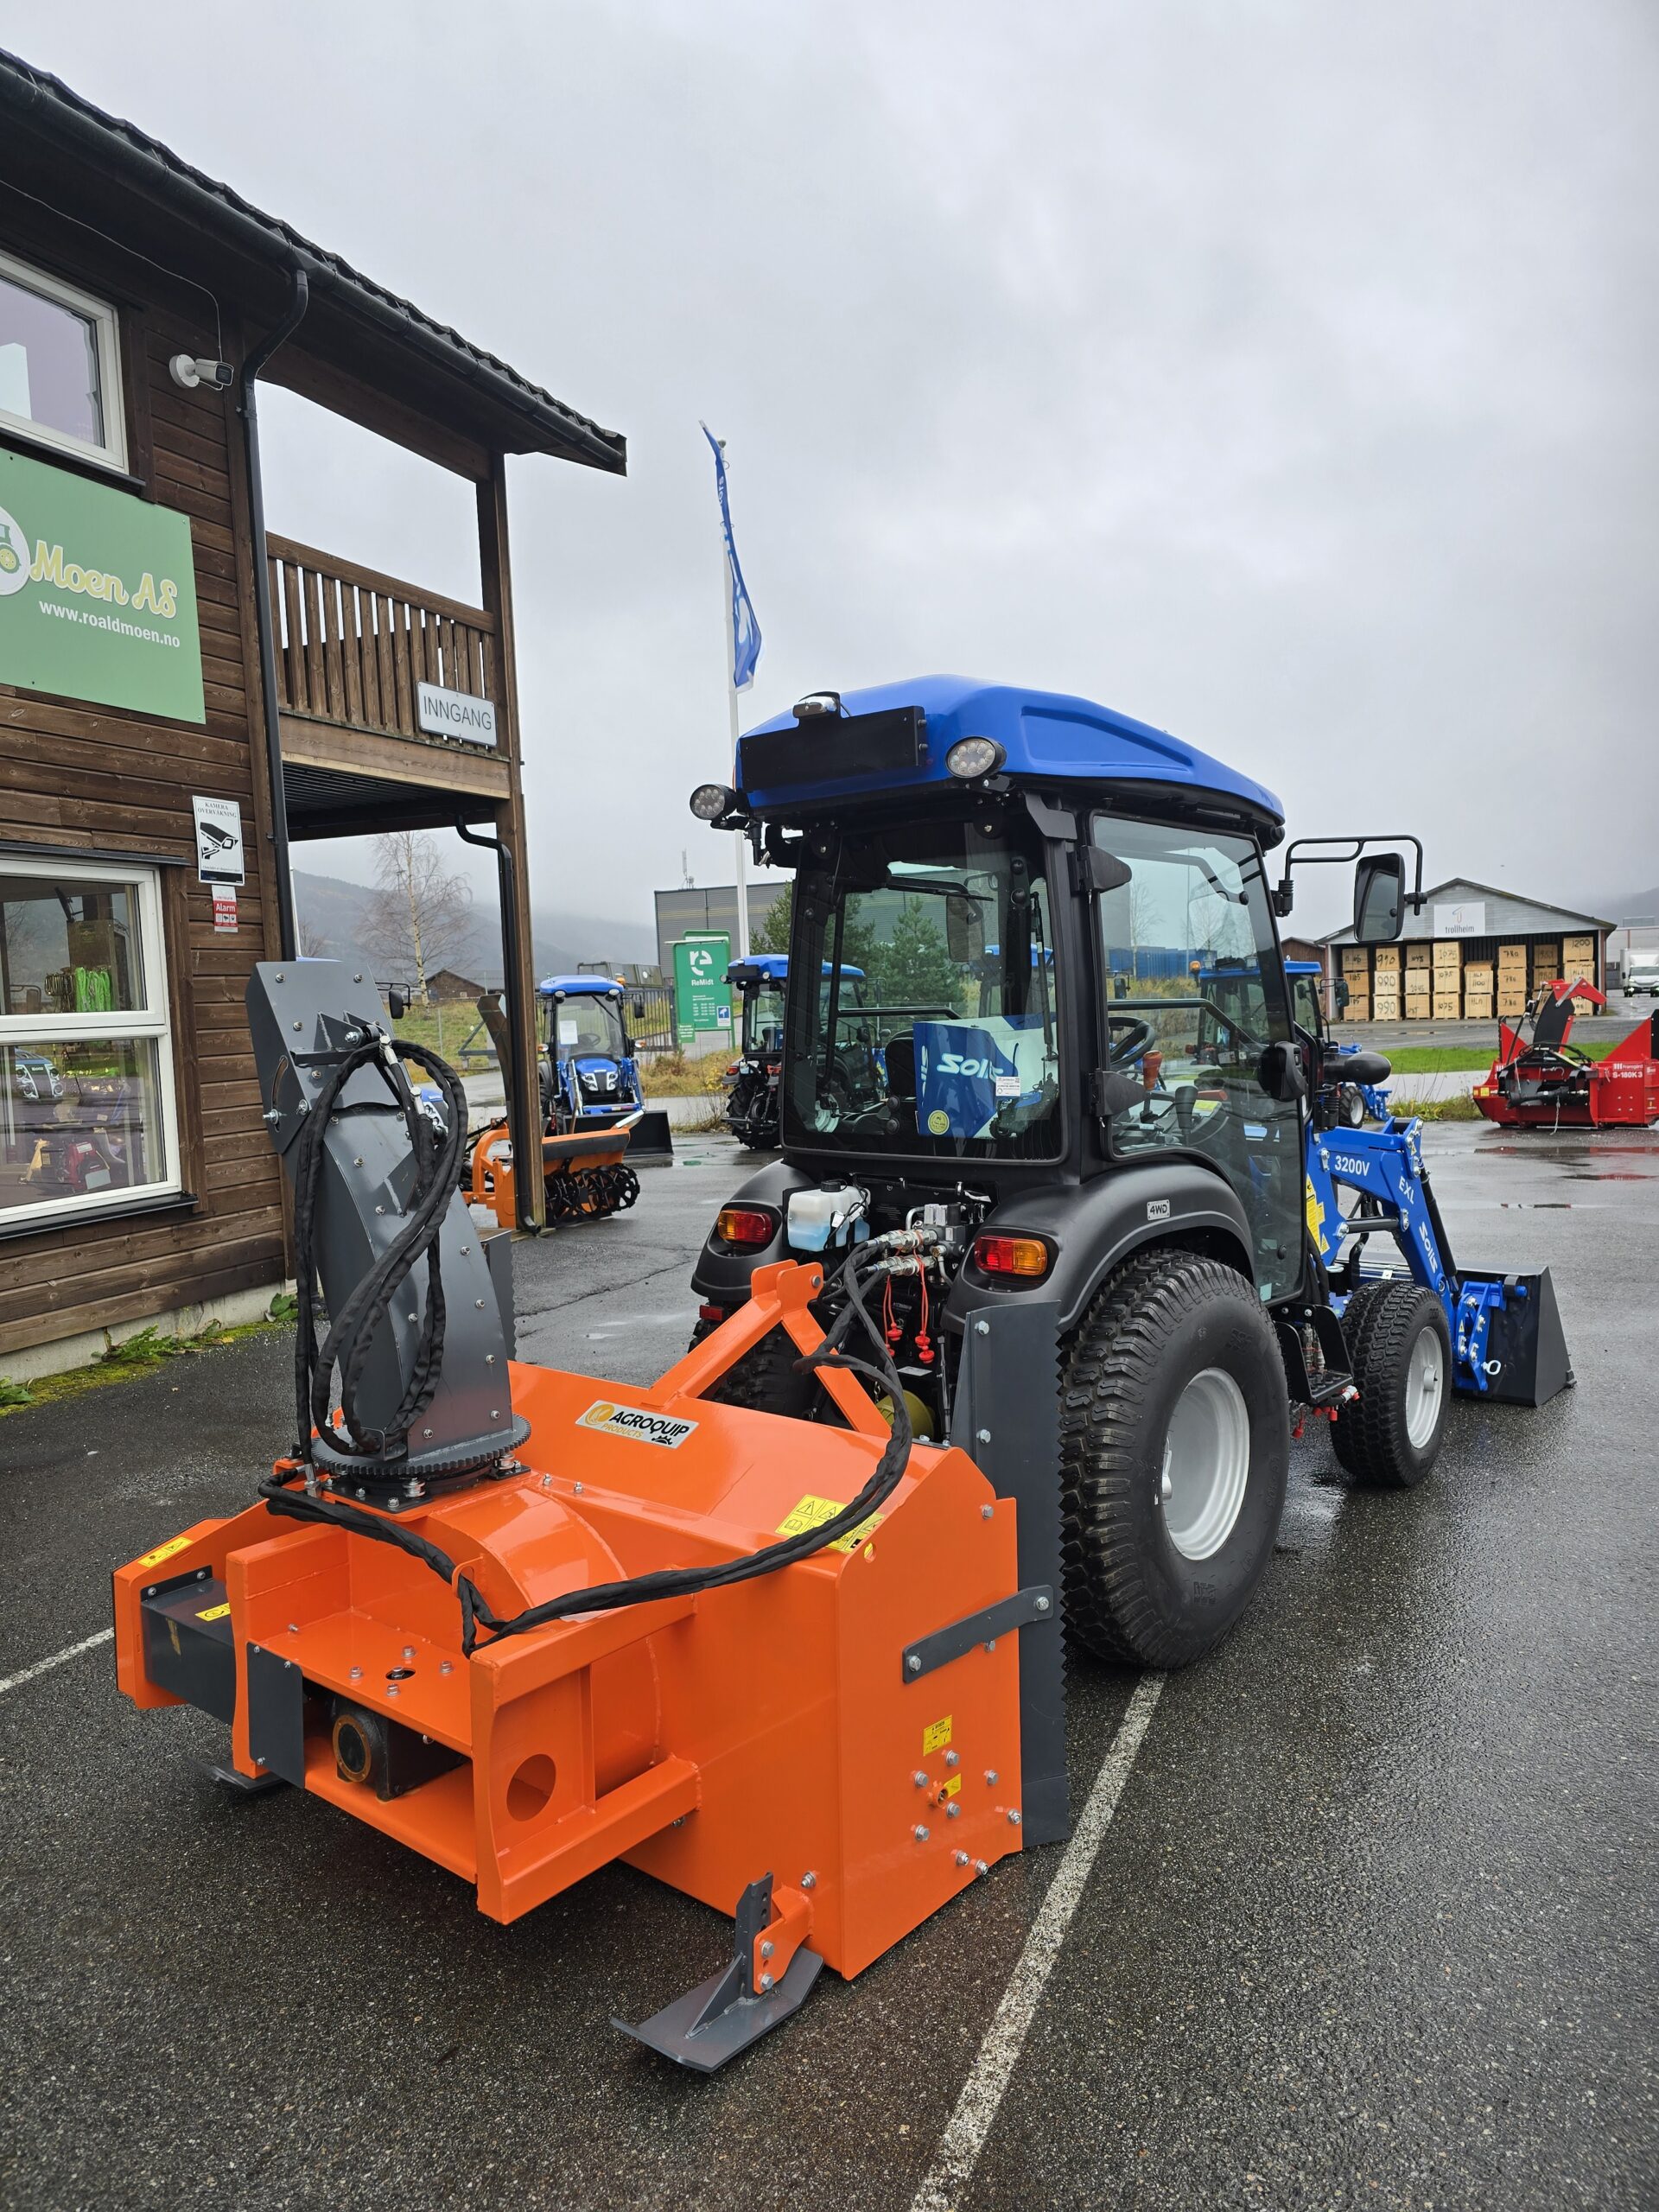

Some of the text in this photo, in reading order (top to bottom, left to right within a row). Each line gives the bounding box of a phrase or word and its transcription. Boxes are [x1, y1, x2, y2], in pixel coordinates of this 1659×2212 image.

[29, 539, 178, 619] Moen AS
[39, 601, 181, 647] www.roaldmoen.no
[423, 696, 492, 730] INNGANG
[205, 802, 229, 810] KAMERA
[215, 903, 236, 912] Alarm
[1445, 925, 1475, 934] trollheim
[1572, 938, 1591, 948] 1200
[1376, 1001, 1396, 1014] 990
[1437, 1001, 1454, 1012] 1075
[1334, 1155, 1370, 1176] 3200V
[1398, 1175, 1414, 1205] EXL
[1149, 1204, 1167, 1215] 4WD
[601, 1423, 645, 1438] PRODUCTS
[608, 1411, 690, 1437] AGROQUIP
